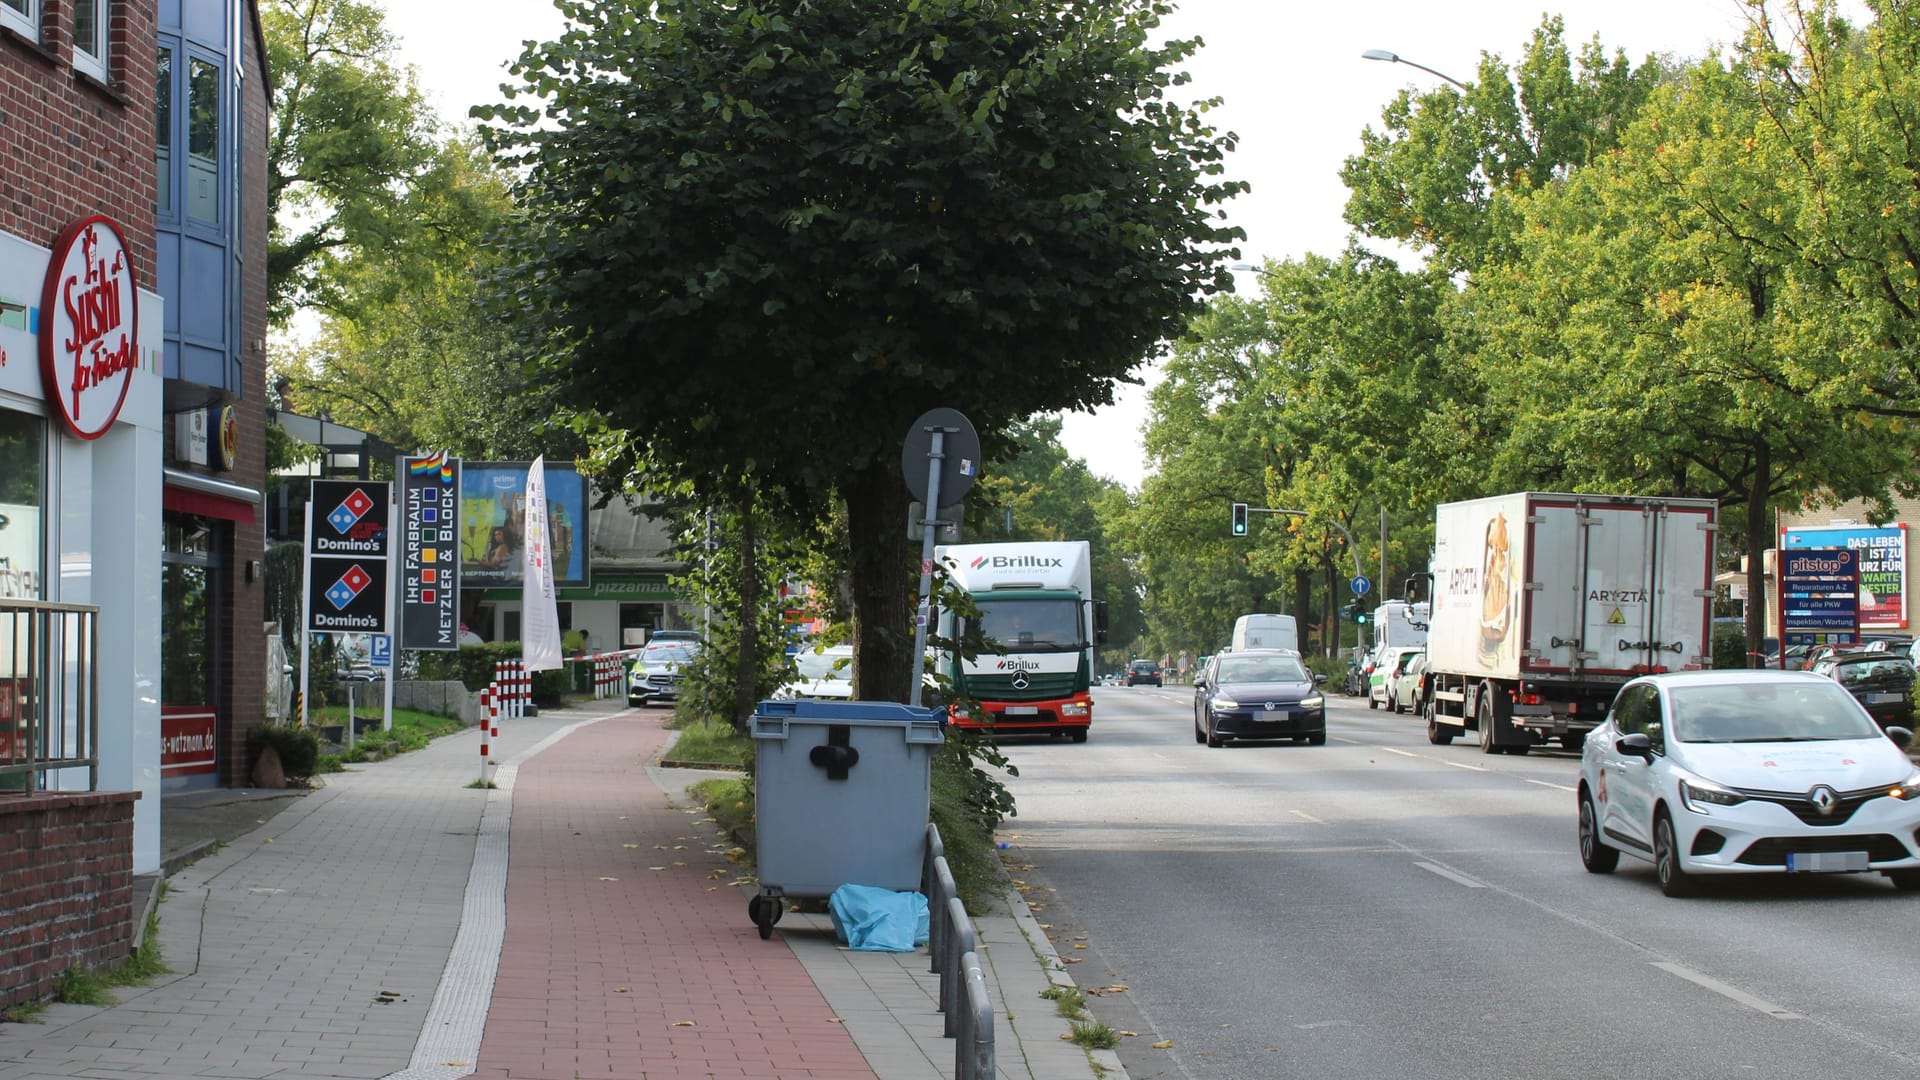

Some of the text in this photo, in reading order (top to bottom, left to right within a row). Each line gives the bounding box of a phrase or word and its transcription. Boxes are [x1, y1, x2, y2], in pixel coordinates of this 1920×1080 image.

[64, 258, 121, 352] Sushi
[317, 537, 381, 551] Domino's
[405, 487, 421, 604] IHR FARBRAUM
[1847, 536, 1902, 548] DAS LEBEN
[1869, 548, 1902, 560] IST ZU
[438, 487, 454, 644] METZLER & BLOCK
[992, 555, 1064, 568] Brillux
[1790, 557, 1841, 575] pitstop
[1859, 559, 1902, 572] URZ FÜR
[1792, 583, 1834, 592] Reparaturen
[1824, 600, 1841, 608] PKW
[315, 613, 379, 627] Domino's
[374, 636, 388, 656] P
[1007, 660, 1041, 670] Brillux
[161, 726, 214, 755] s-watzmann.de
